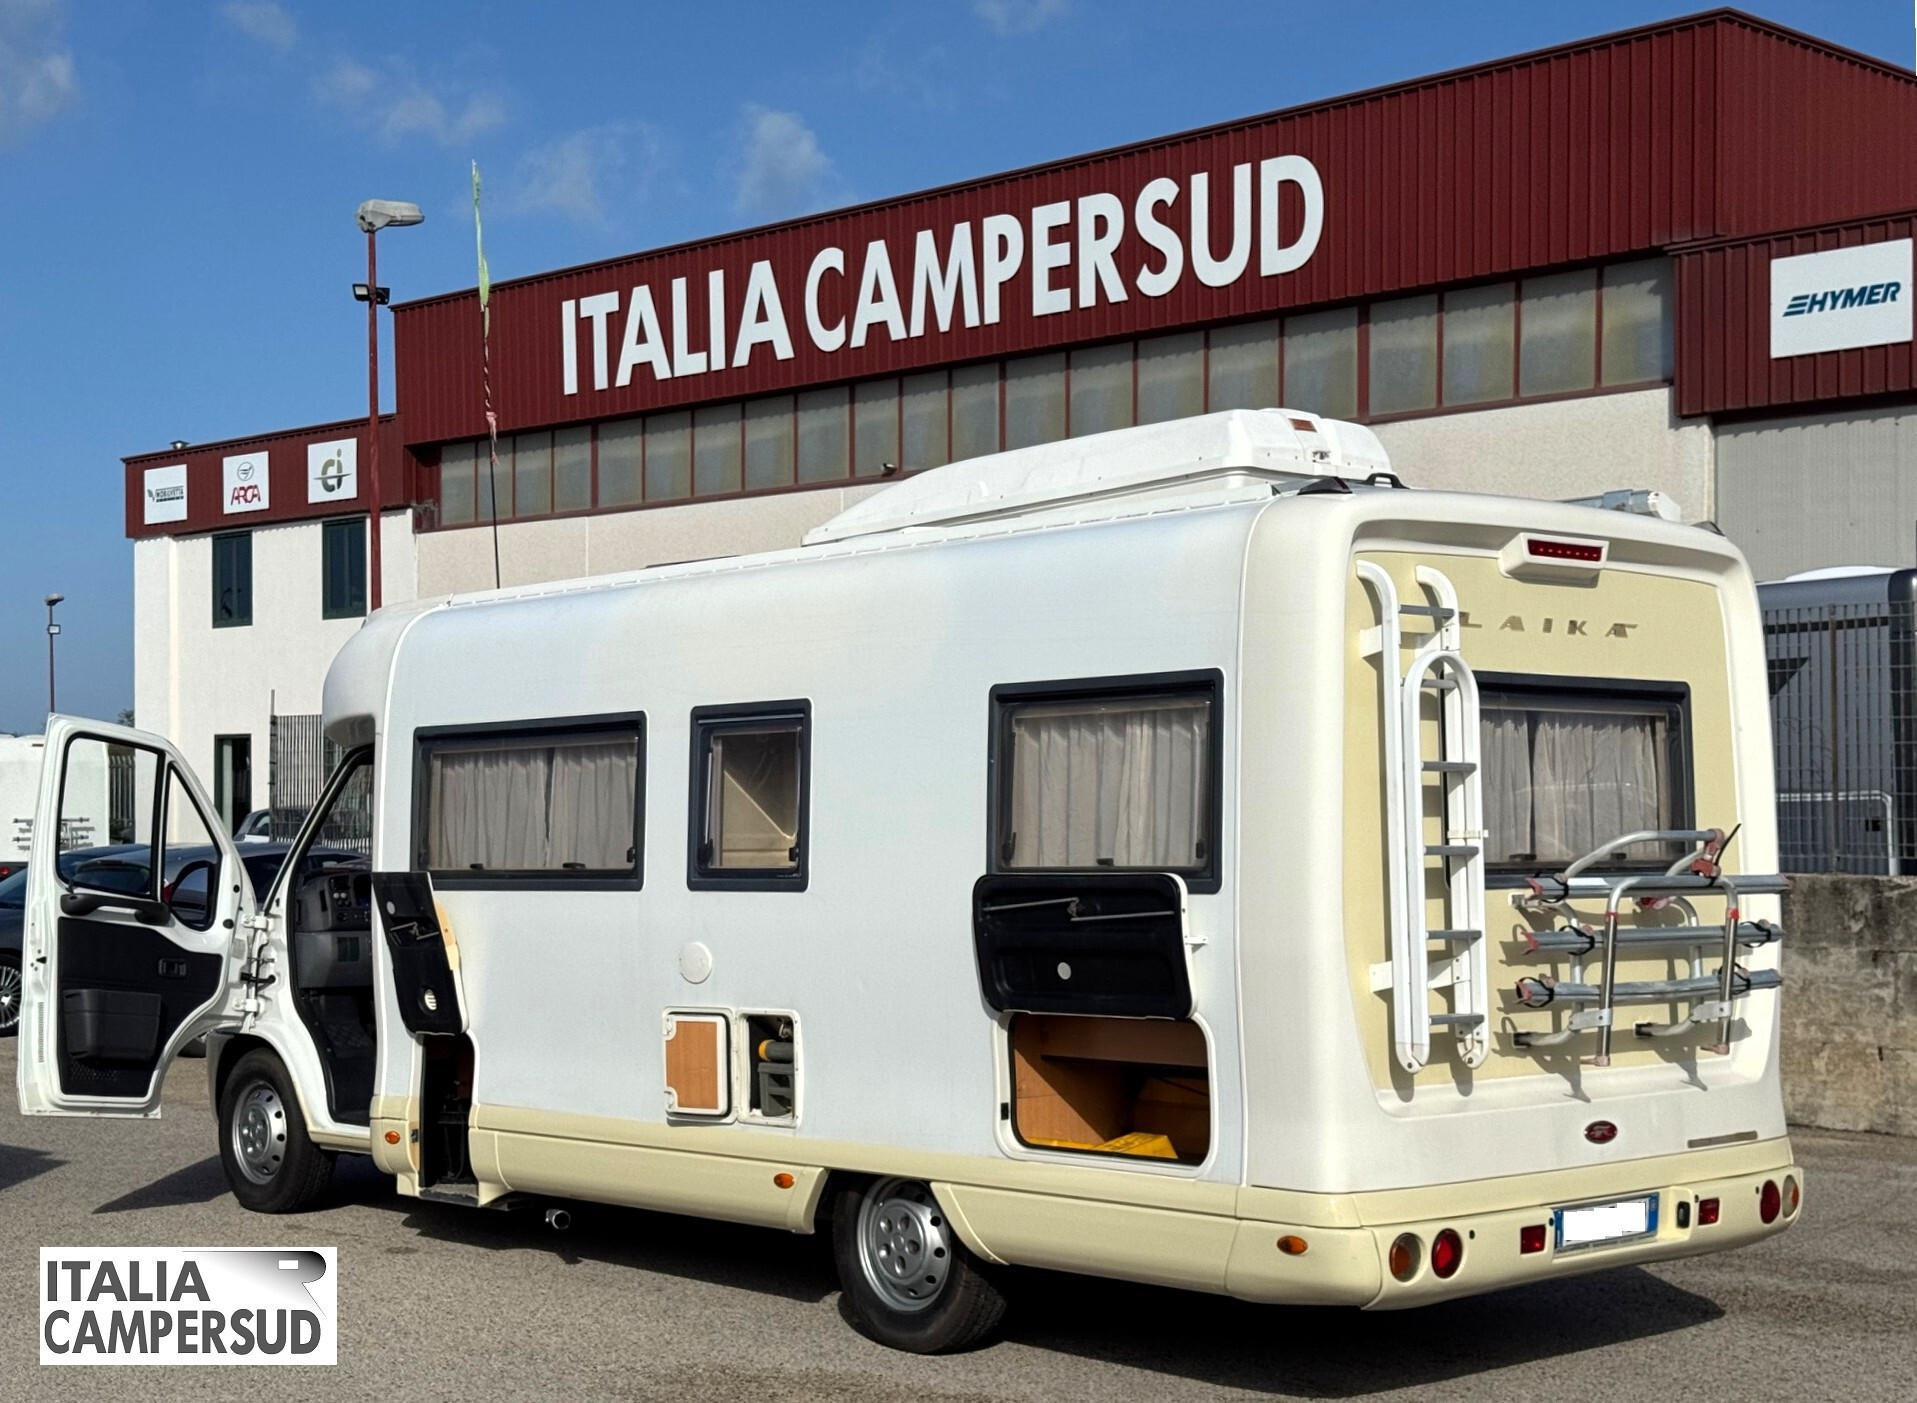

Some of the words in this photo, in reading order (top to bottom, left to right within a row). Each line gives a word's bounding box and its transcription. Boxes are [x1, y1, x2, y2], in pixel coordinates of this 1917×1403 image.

[561, 259, 796, 396] ITALIA
[804, 154, 1324, 352] CAMPERSUD
[1806, 281, 1902, 314] HYMER
[230, 484, 262, 506] ARCA
[1459, 611, 1639, 639] LAIKA
